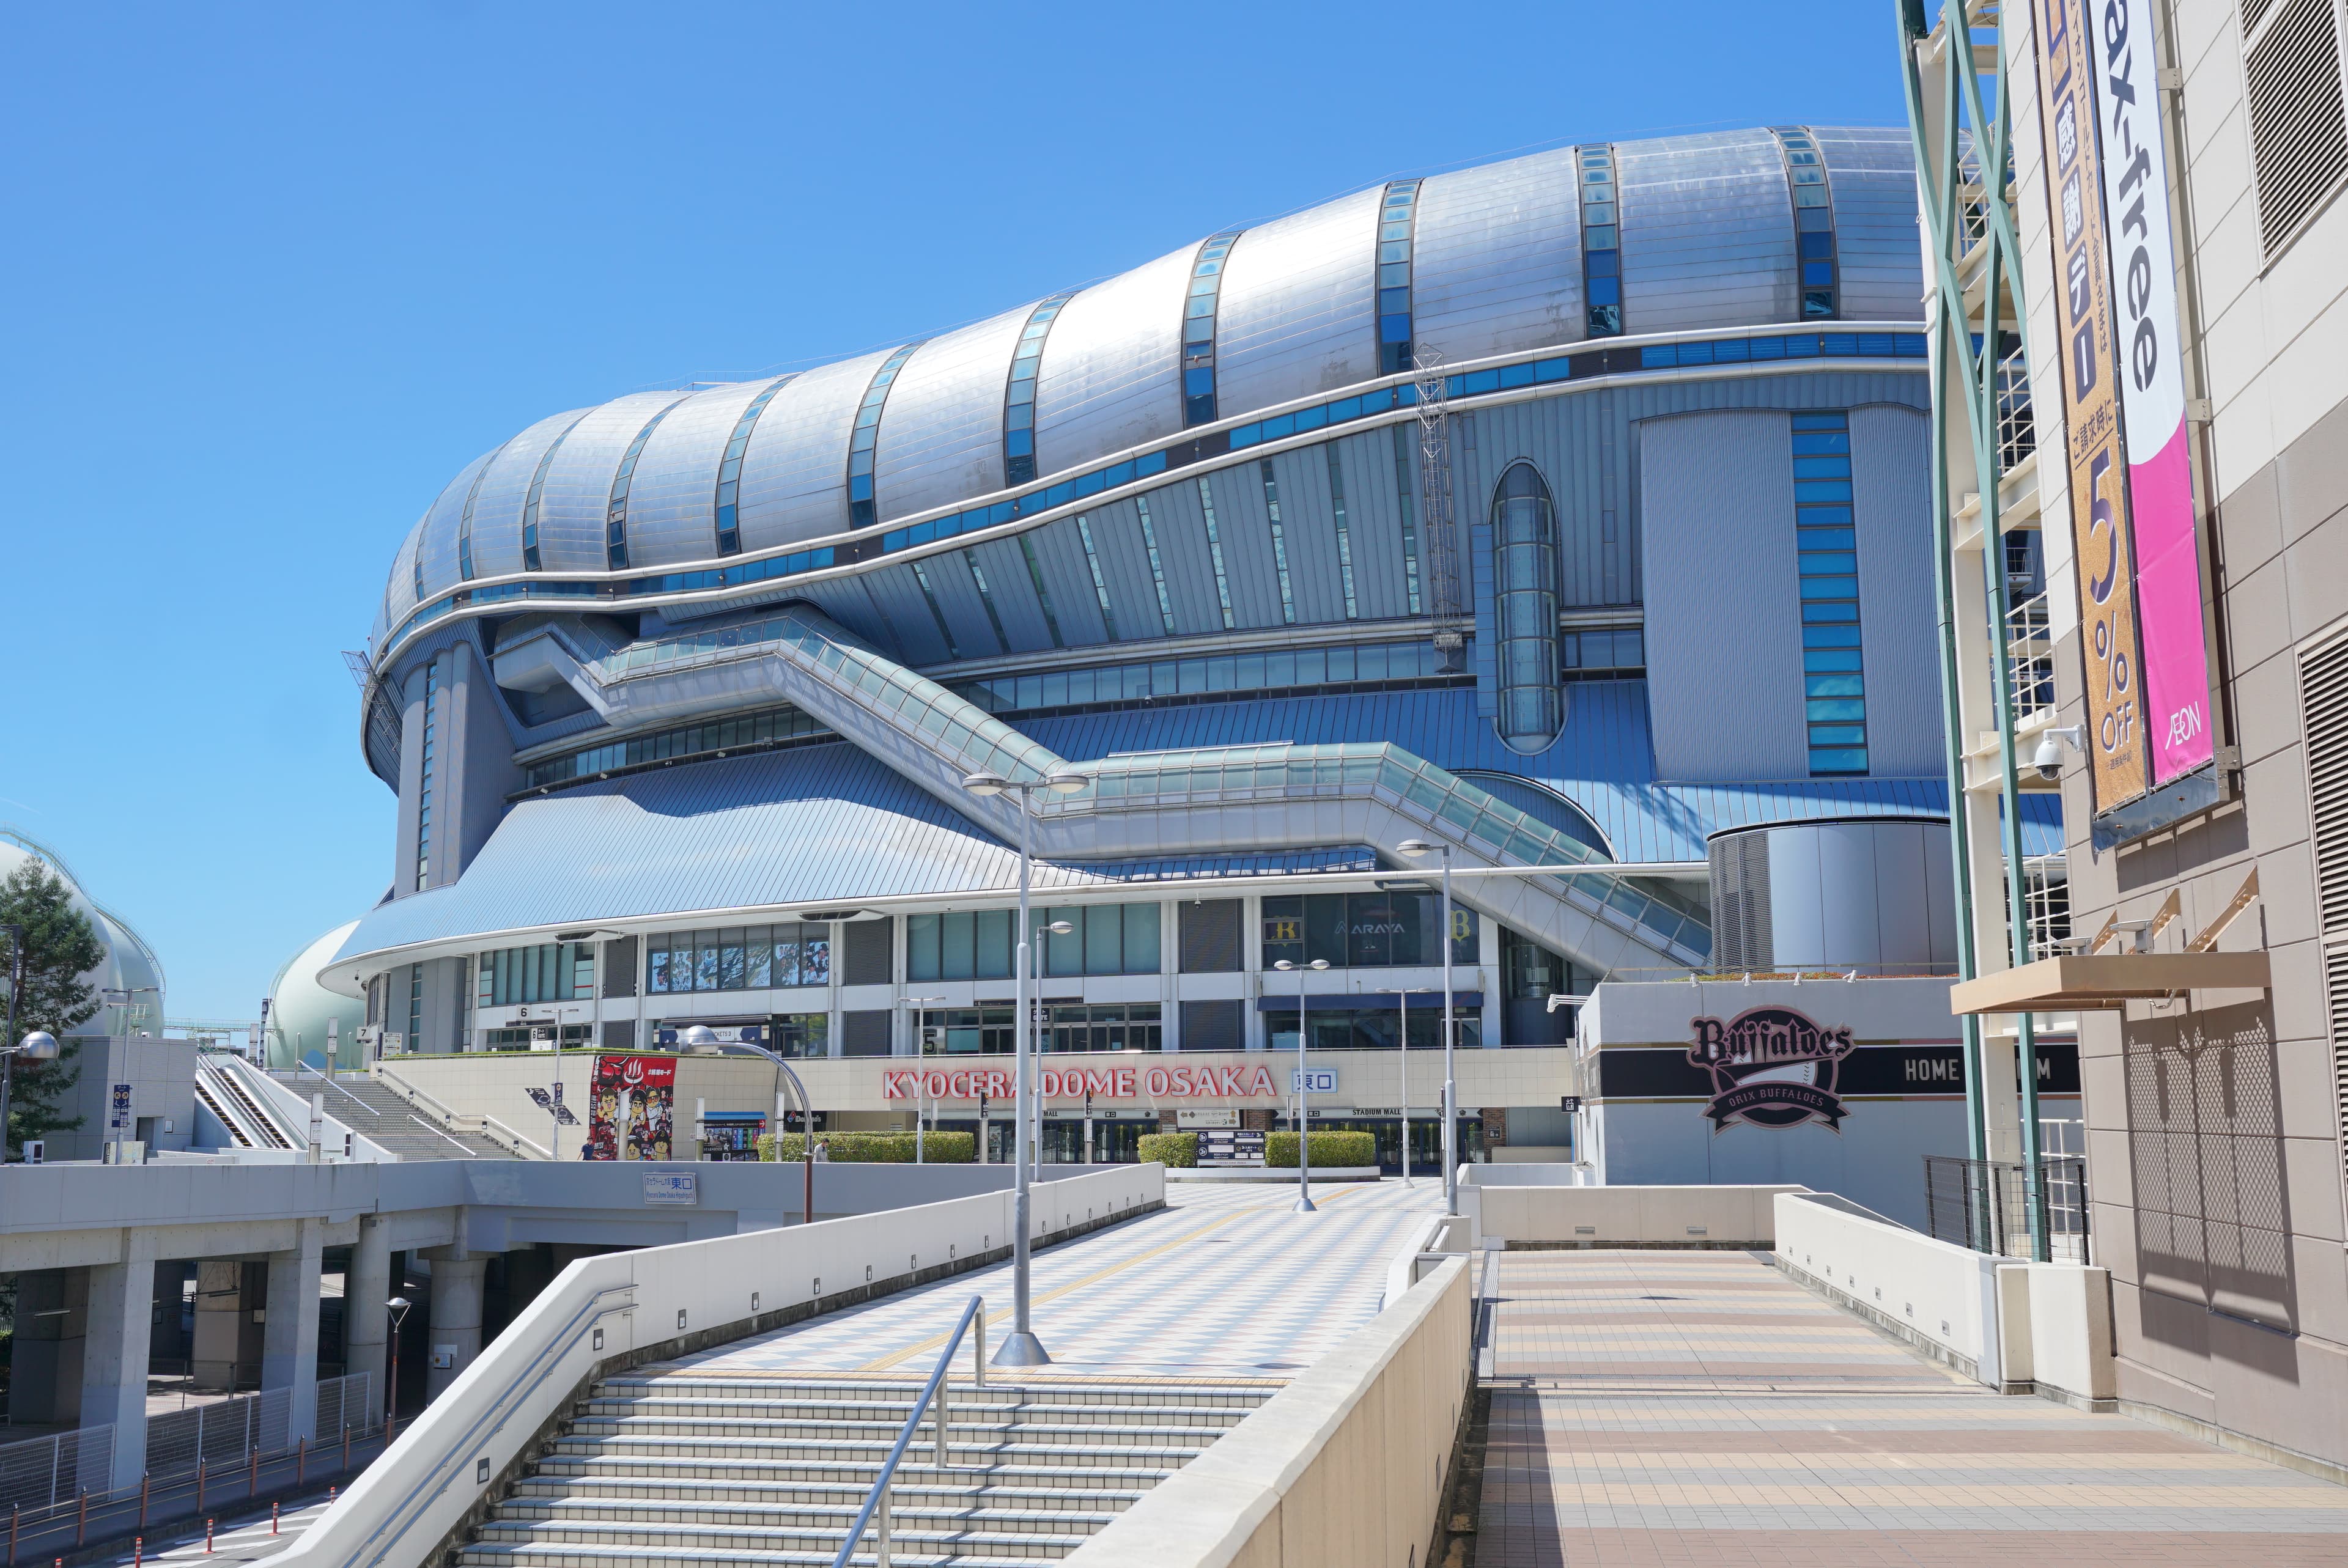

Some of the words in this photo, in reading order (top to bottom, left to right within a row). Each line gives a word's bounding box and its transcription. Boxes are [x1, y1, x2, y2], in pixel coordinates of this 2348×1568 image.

[2058, 100, 2088, 387] 感謝デー
[2073, 399, 2113, 460] ご請求時に
[2102, 700, 2133, 753] OFF
[1351, 923, 1405, 934] ARAYA
[520, 1007, 528, 1017] 6
[533, 1030, 536, 1039] 6
[924, 1033, 935, 1053] 5
[1689, 1017, 1853, 1065] Buffaloes
[1905, 1059, 1960, 1081] HOME
[1041, 1069, 1135, 1098] DOME
[1144, 1067, 1277, 1097] OSAKA
[1729, 1091, 1755, 1107] ORIX
[1760, 1088, 1824, 1106] BUFFALOES
[671, 1177, 692, 1190] 東口
